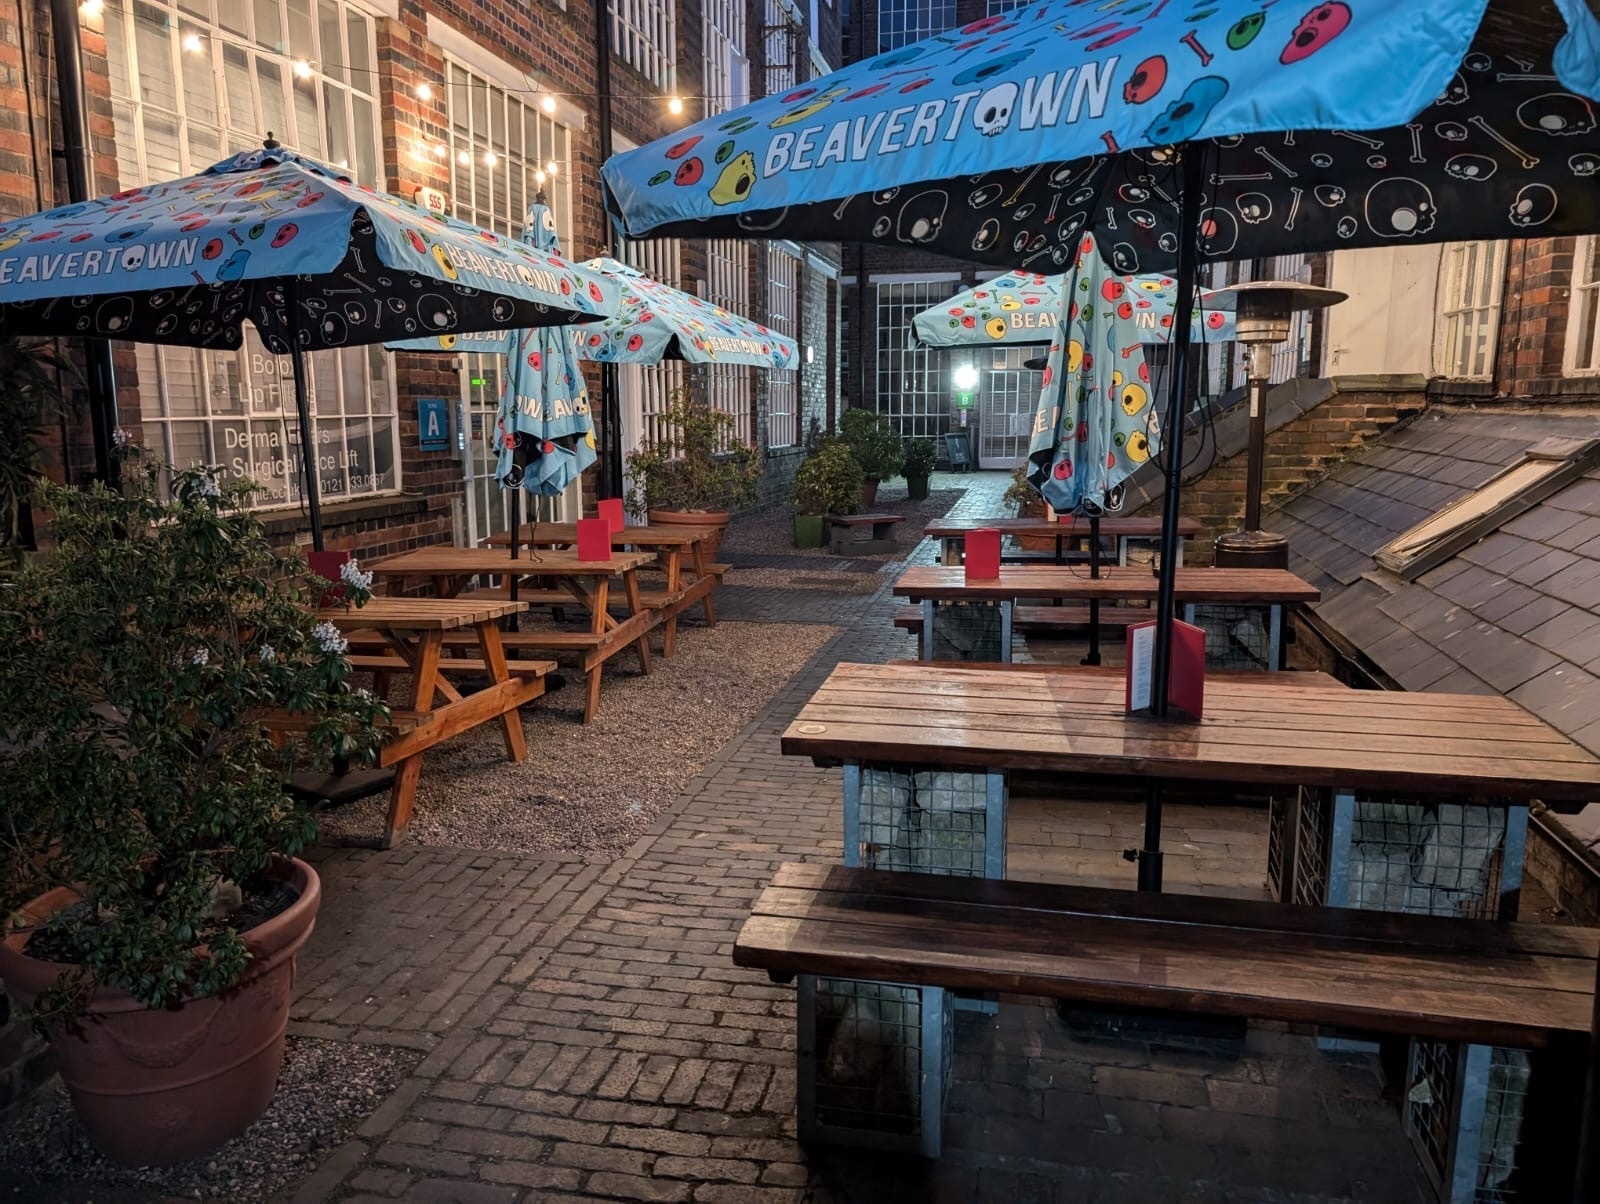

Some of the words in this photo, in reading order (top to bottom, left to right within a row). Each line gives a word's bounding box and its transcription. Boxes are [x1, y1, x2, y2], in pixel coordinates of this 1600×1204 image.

[763, 54, 1121, 179] BEAVERTOWN
[0, 237, 200, 284] EAVERTOWN
[443, 241, 561, 296] BEAVERTOWN
[428, 410, 440, 437] A
[232, 453, 298, 482] Surgical
